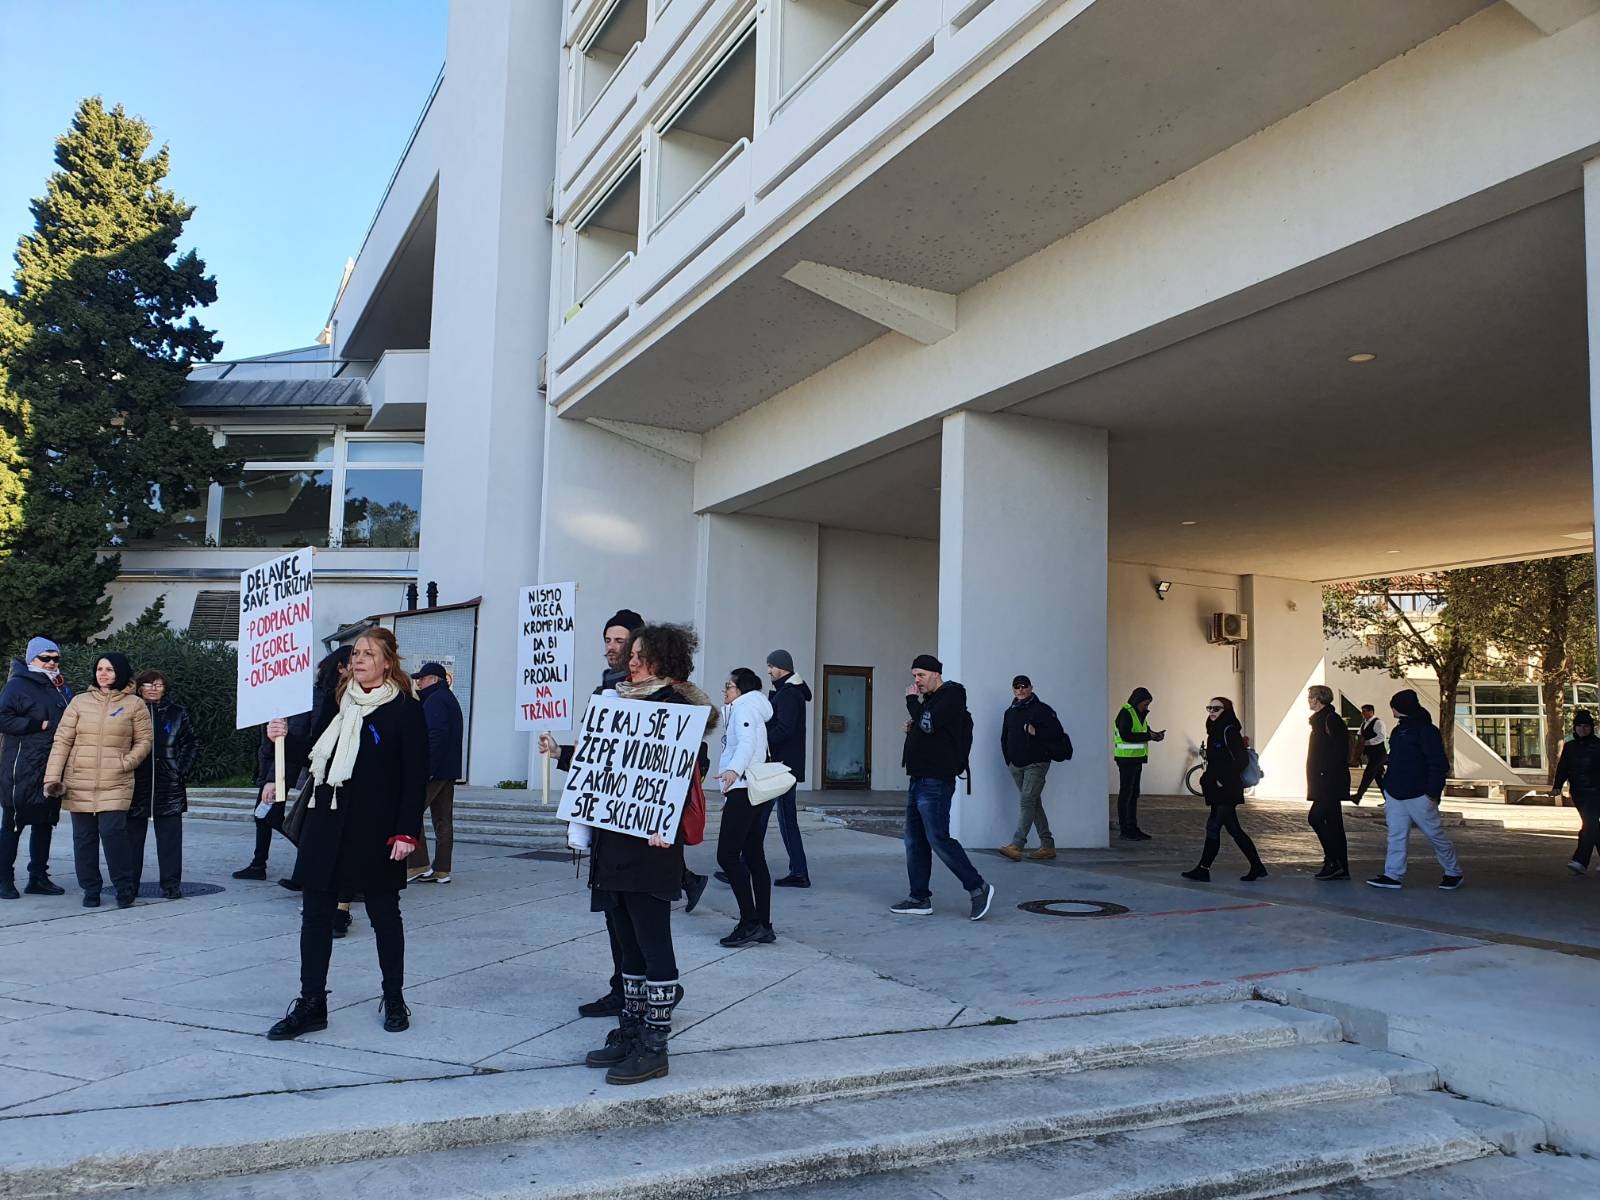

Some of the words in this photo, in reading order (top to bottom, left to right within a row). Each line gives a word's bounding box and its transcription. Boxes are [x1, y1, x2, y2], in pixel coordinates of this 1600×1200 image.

[247, 555, 301, 593] DELAVEC
[242, 589, 269, 613] SAVE
[274, 571, 313, 601] TURIZMA
[529, 588, 561, 604] NISMO
[530, 601, 563, 617] VREČA
[523, 616, 574, 636] KROMPIRJA
[533, 637, 545, 651] DA
[548, 636, 557, 648] BI
[533, 651, 555, 666] NAS
[524, 664, 568, 685] PRODALI
[536, 685, 552, 698] NA
[521, 698, 567, 721] TRŽNICI
[585, 706, 609, 733] LE
[611, 710, 640, 736] KAJ
[643, 708, 670, 740] STE
[675, 714, 691, 741] V
[575, 733, 619, 766] ŽEPE
[622, 739, 640, 769] VI
[675, 749, 695, 780] DA
[566, 766, 582, 791] Z
[580, 766, 627, 798] AKTIVO
[632, 775, 669, 806] POSEL
[571, 793, 599, 821] STE
[600, 799, 676, 837] SKLENILI?
